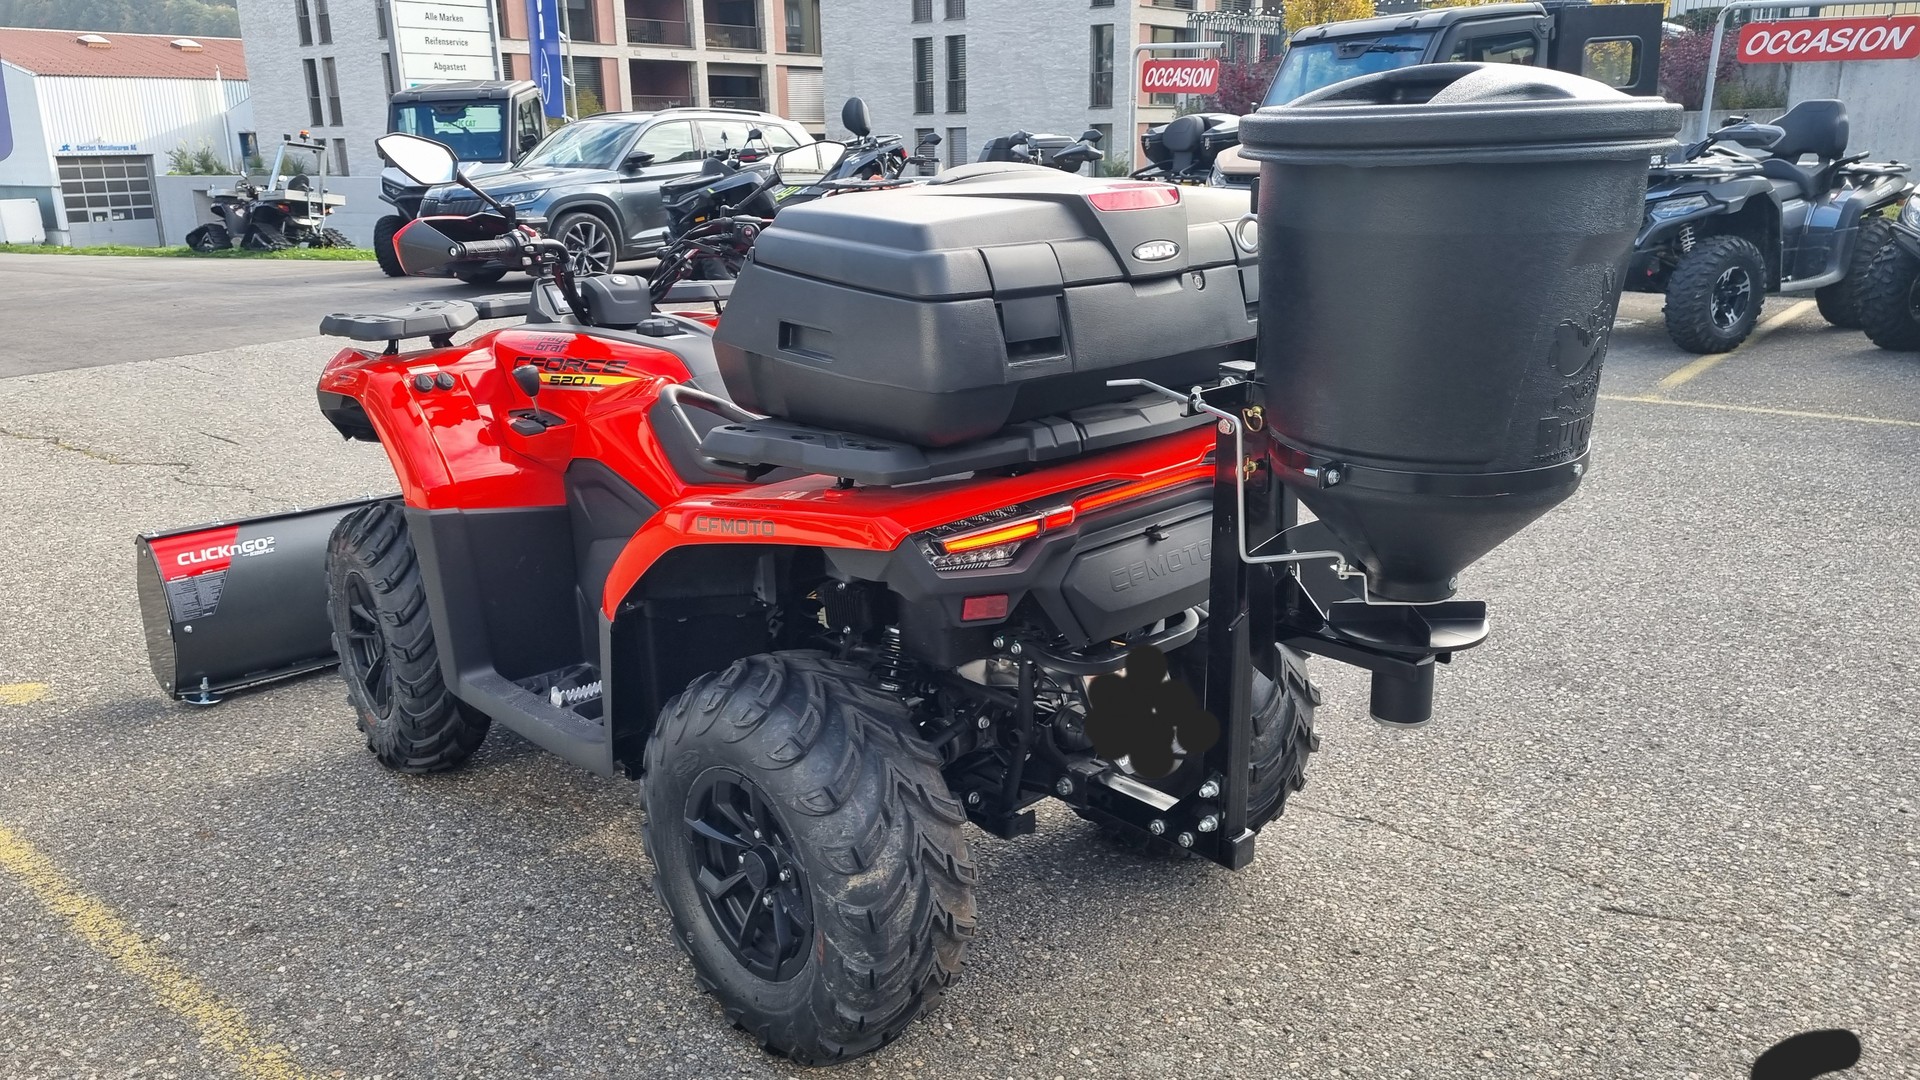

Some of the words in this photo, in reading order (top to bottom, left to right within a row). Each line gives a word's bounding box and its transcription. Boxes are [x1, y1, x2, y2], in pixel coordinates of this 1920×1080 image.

[425, 12, 438, 21] Alle
[439, 13, 464, 22] Marken
[424, 37, 469, 47] Reifenservice
[1745, 25, 1916, 56] OCCASION
[434, 62, 467, 72] Abgastest
[1145, 67, 1216, 88] OCCASION
[1138, 244, 1176, 259] SHAD
[513, 356, 628, 374] CFORCE
[549, 375, 586, 386] 520
[696, 515, 775, 537] CFMOTO
[1109, 538, 1212, 593] CFMOTO
